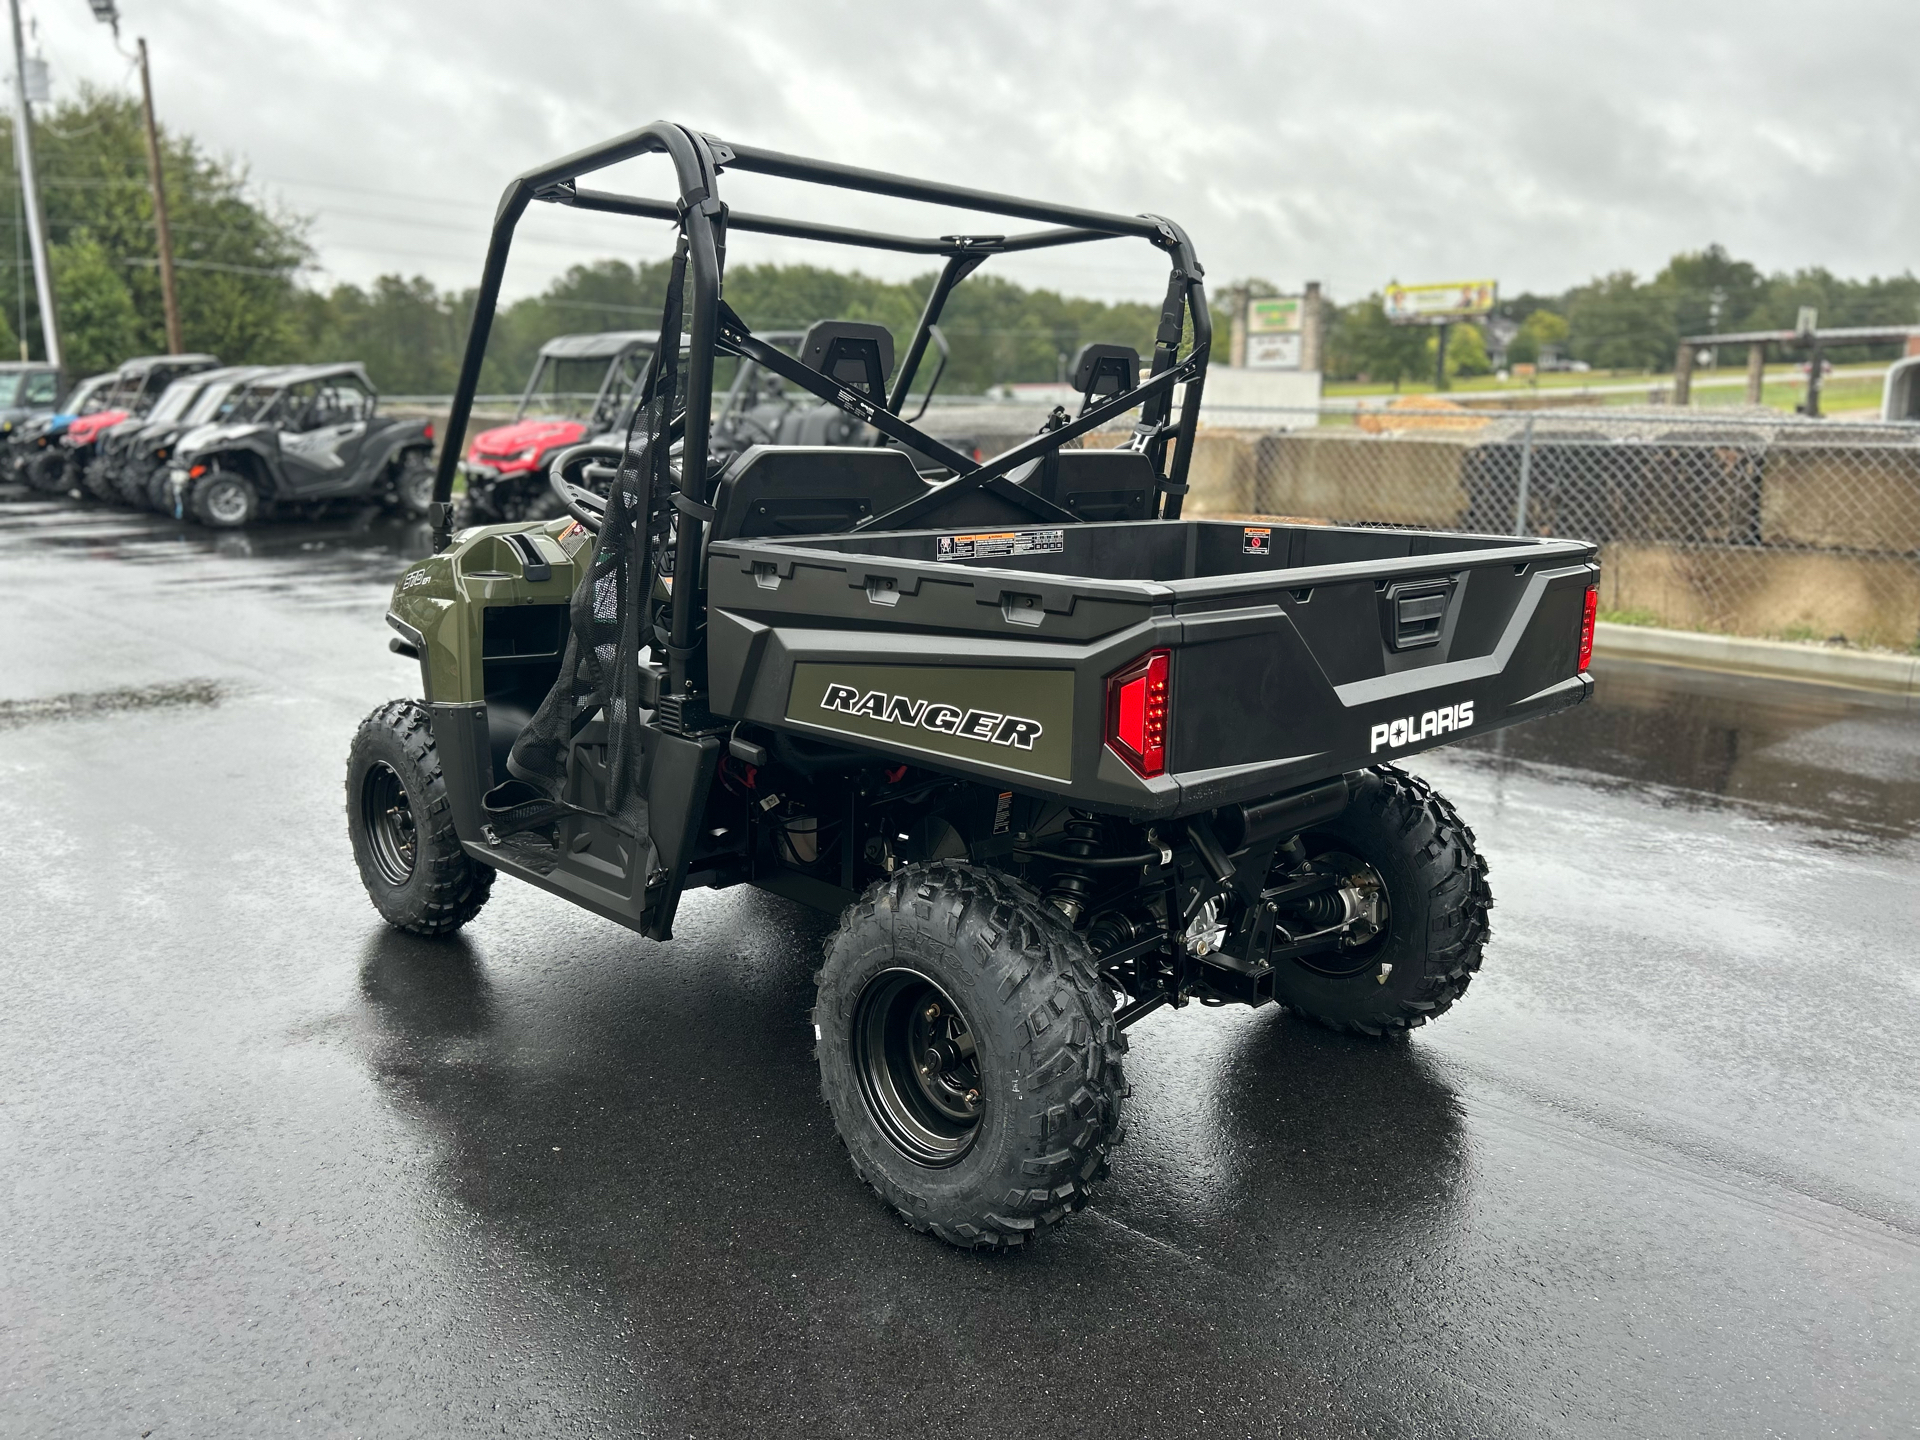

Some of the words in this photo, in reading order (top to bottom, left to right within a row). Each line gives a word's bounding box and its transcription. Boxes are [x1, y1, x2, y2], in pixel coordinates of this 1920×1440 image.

[403, 568, 425, 590] 570
[820, 683, 1043, 751] RANGER
[1370, 700, 1474, 754] POLARIS
